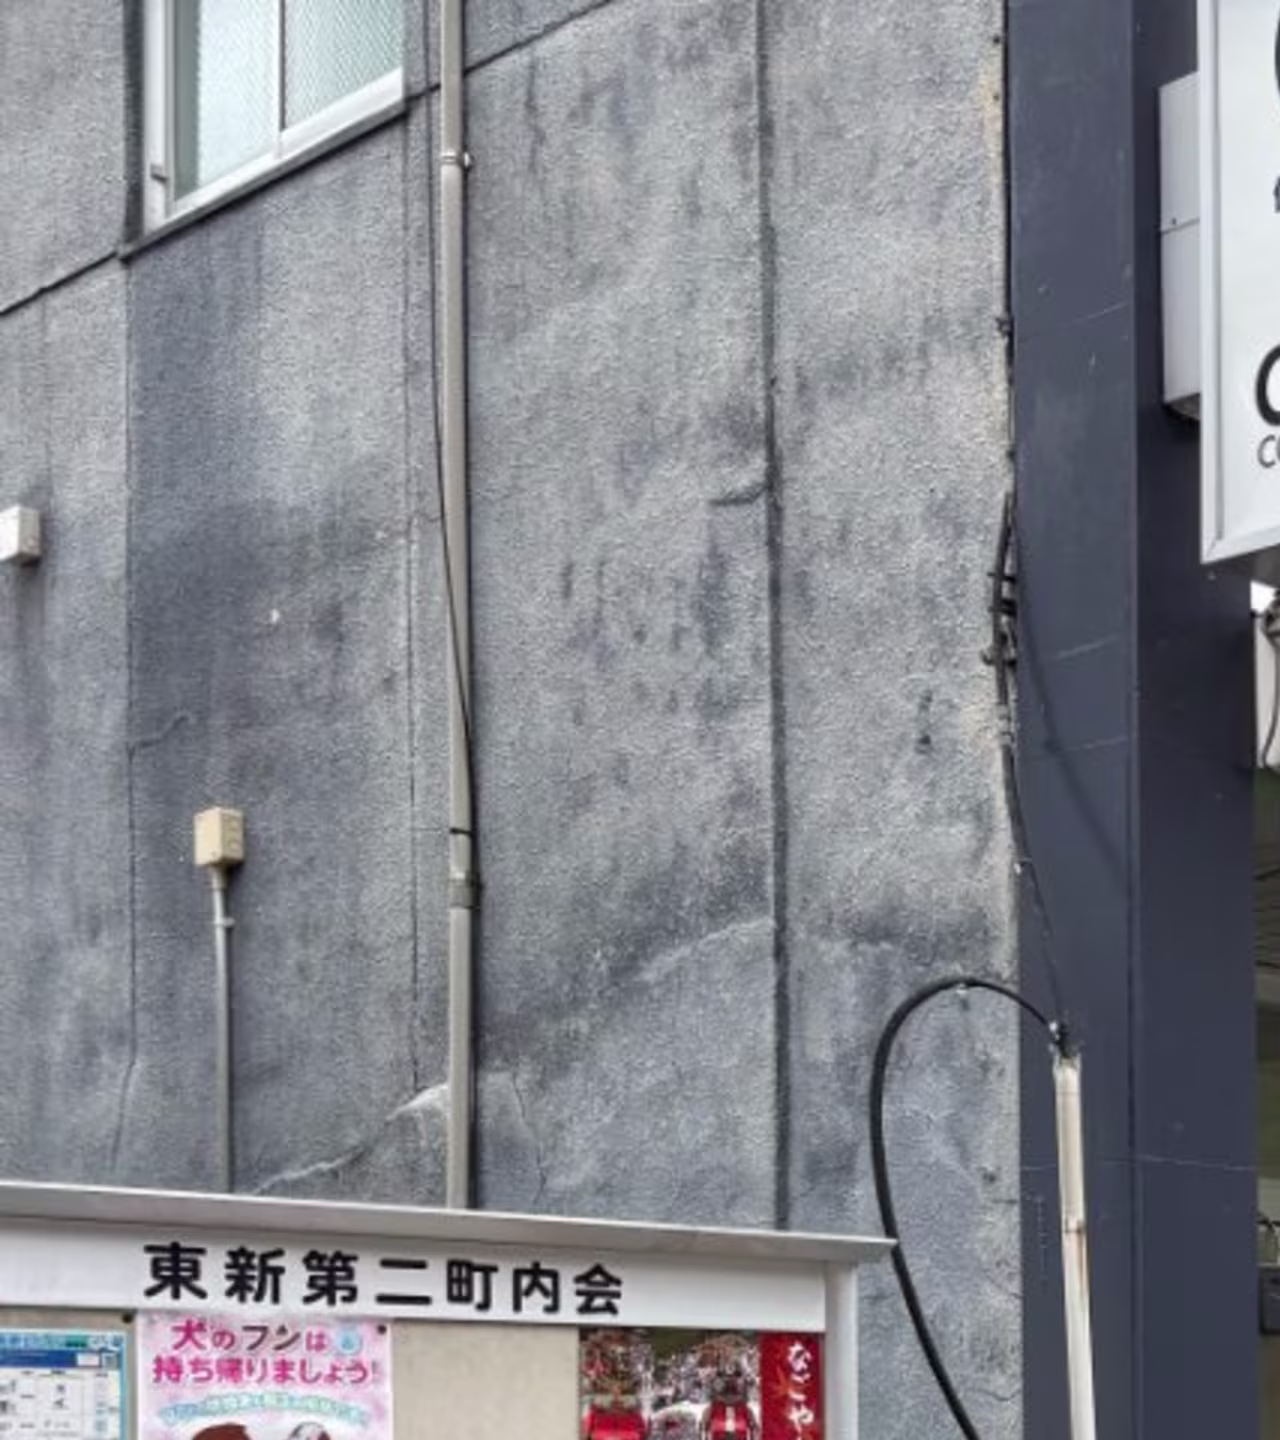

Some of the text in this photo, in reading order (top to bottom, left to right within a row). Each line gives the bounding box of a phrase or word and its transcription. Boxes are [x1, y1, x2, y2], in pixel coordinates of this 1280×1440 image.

[143, 1241, 623, 1316] 東新第二町内会
[171, 1319, 329, 1352] 犬のフンは
